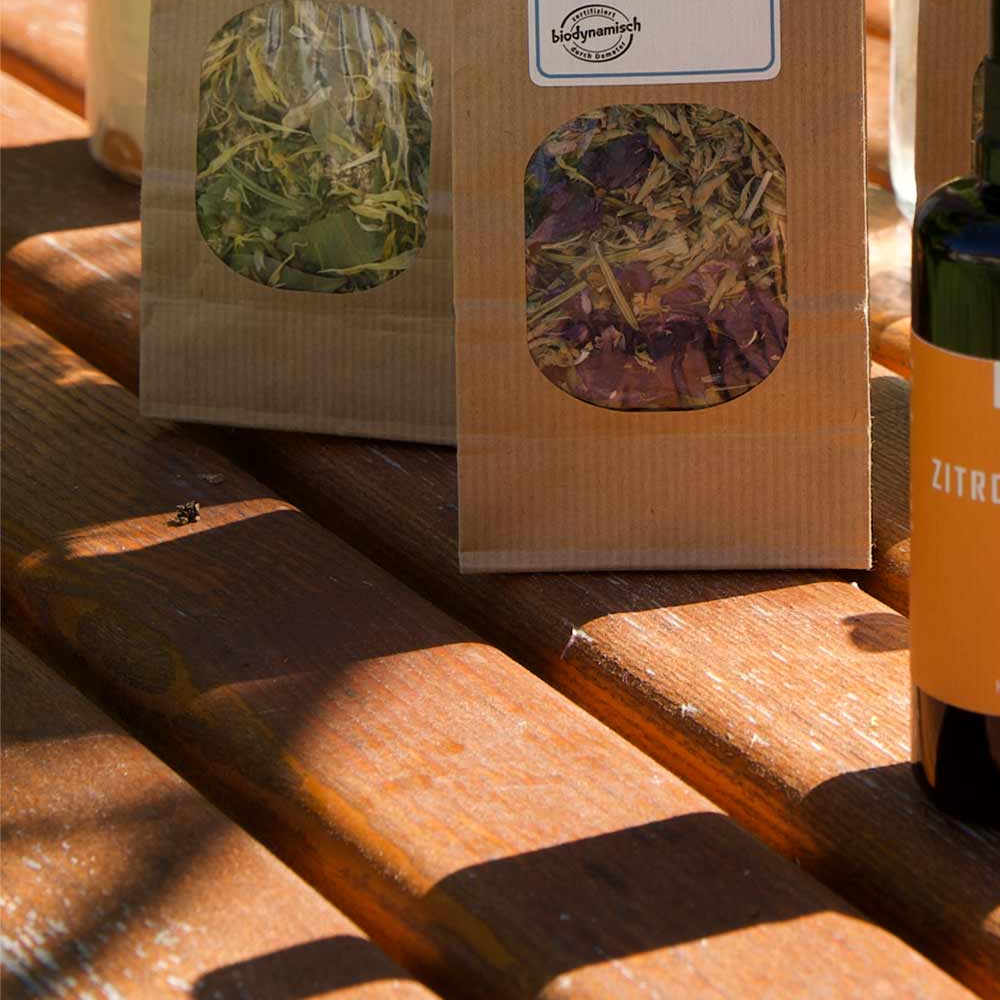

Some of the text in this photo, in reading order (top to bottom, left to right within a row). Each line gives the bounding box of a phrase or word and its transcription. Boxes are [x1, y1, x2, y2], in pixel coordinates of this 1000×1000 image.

[551, 16, 642, 44] biodynamisch
[570, 41, 627, 60] durch Demeter
